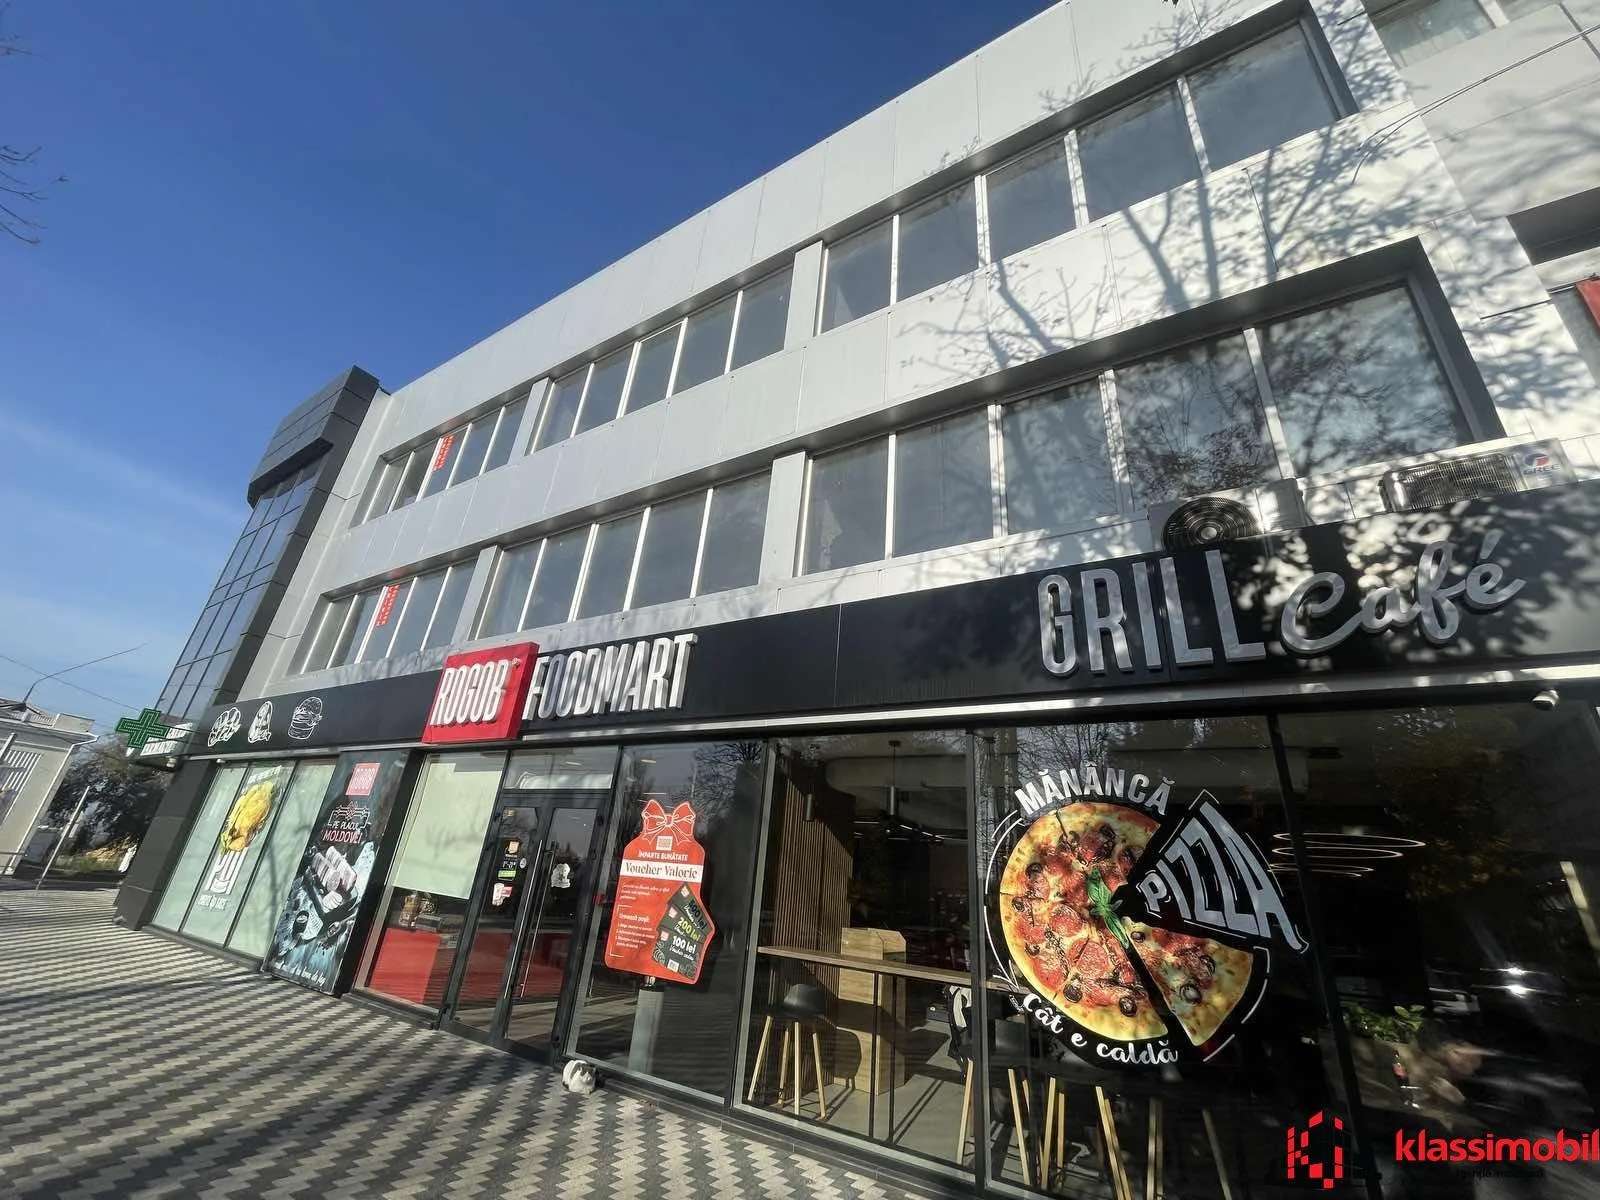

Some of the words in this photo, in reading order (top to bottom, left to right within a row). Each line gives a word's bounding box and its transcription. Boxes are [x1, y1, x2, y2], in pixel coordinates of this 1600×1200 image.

[1037, 550, 1266, 678] GRILL
[1280, 530, 1526, 659] Café
[430, 660, 512, 727] ROGOB
[522, 633, 698, 721] FOODMART
[1014, 762, 1176, 815] MĂNÂNCĂ
[625, 862, 662, 876] Voucher
[1138, 801, 1304, 951] PIZZA
[672, 936, 686, 949] 100
[686, 941, 697, 954] lei
[677, 917, 692, 934] 200
[1023, 993, 1064, 1034] Cât
[1071, 1032, 1087, 1047] e
[1096, 1040, 1179, 1066] caldă
